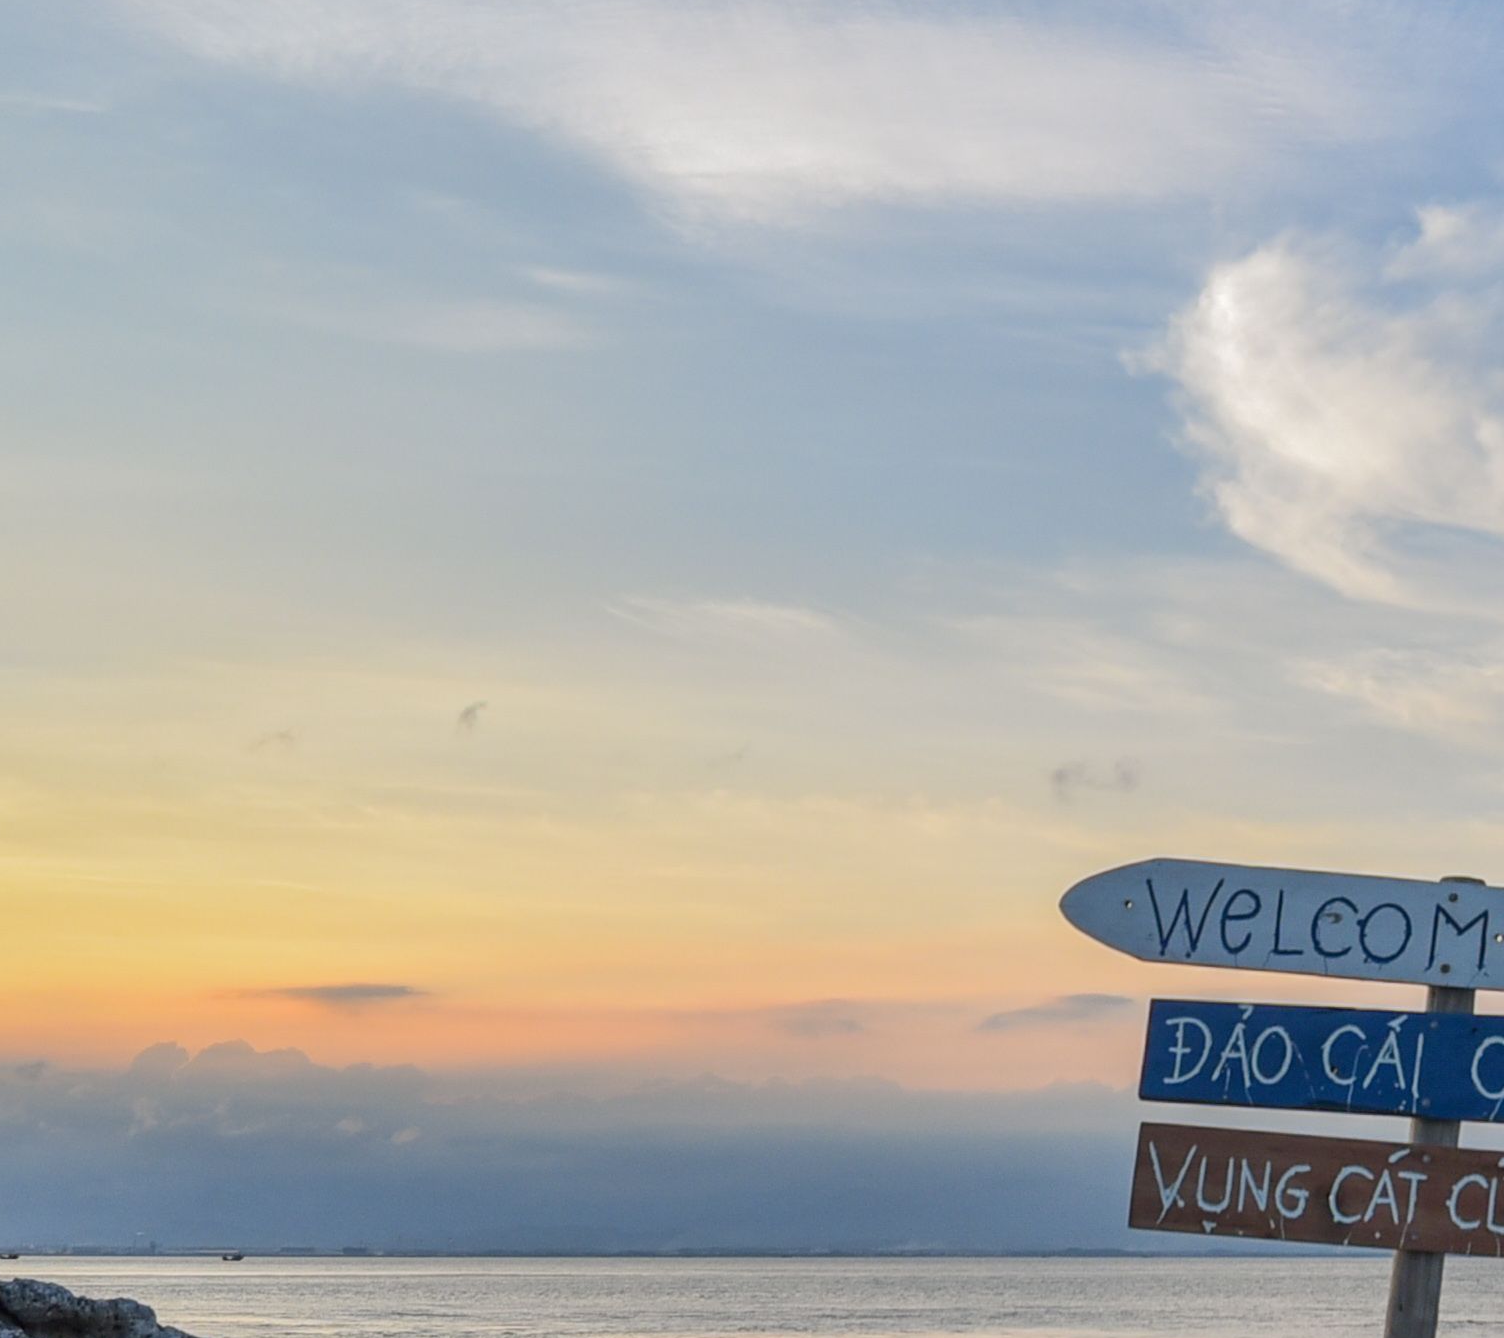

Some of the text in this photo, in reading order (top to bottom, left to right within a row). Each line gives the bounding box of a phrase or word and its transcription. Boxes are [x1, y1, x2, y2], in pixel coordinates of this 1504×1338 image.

[1162, 1004, 1294, 1089] ĐẢO
[1321, 1014, 1424, 1100] CÁI
[1328, 1148, 1429, 1226] CÁT
